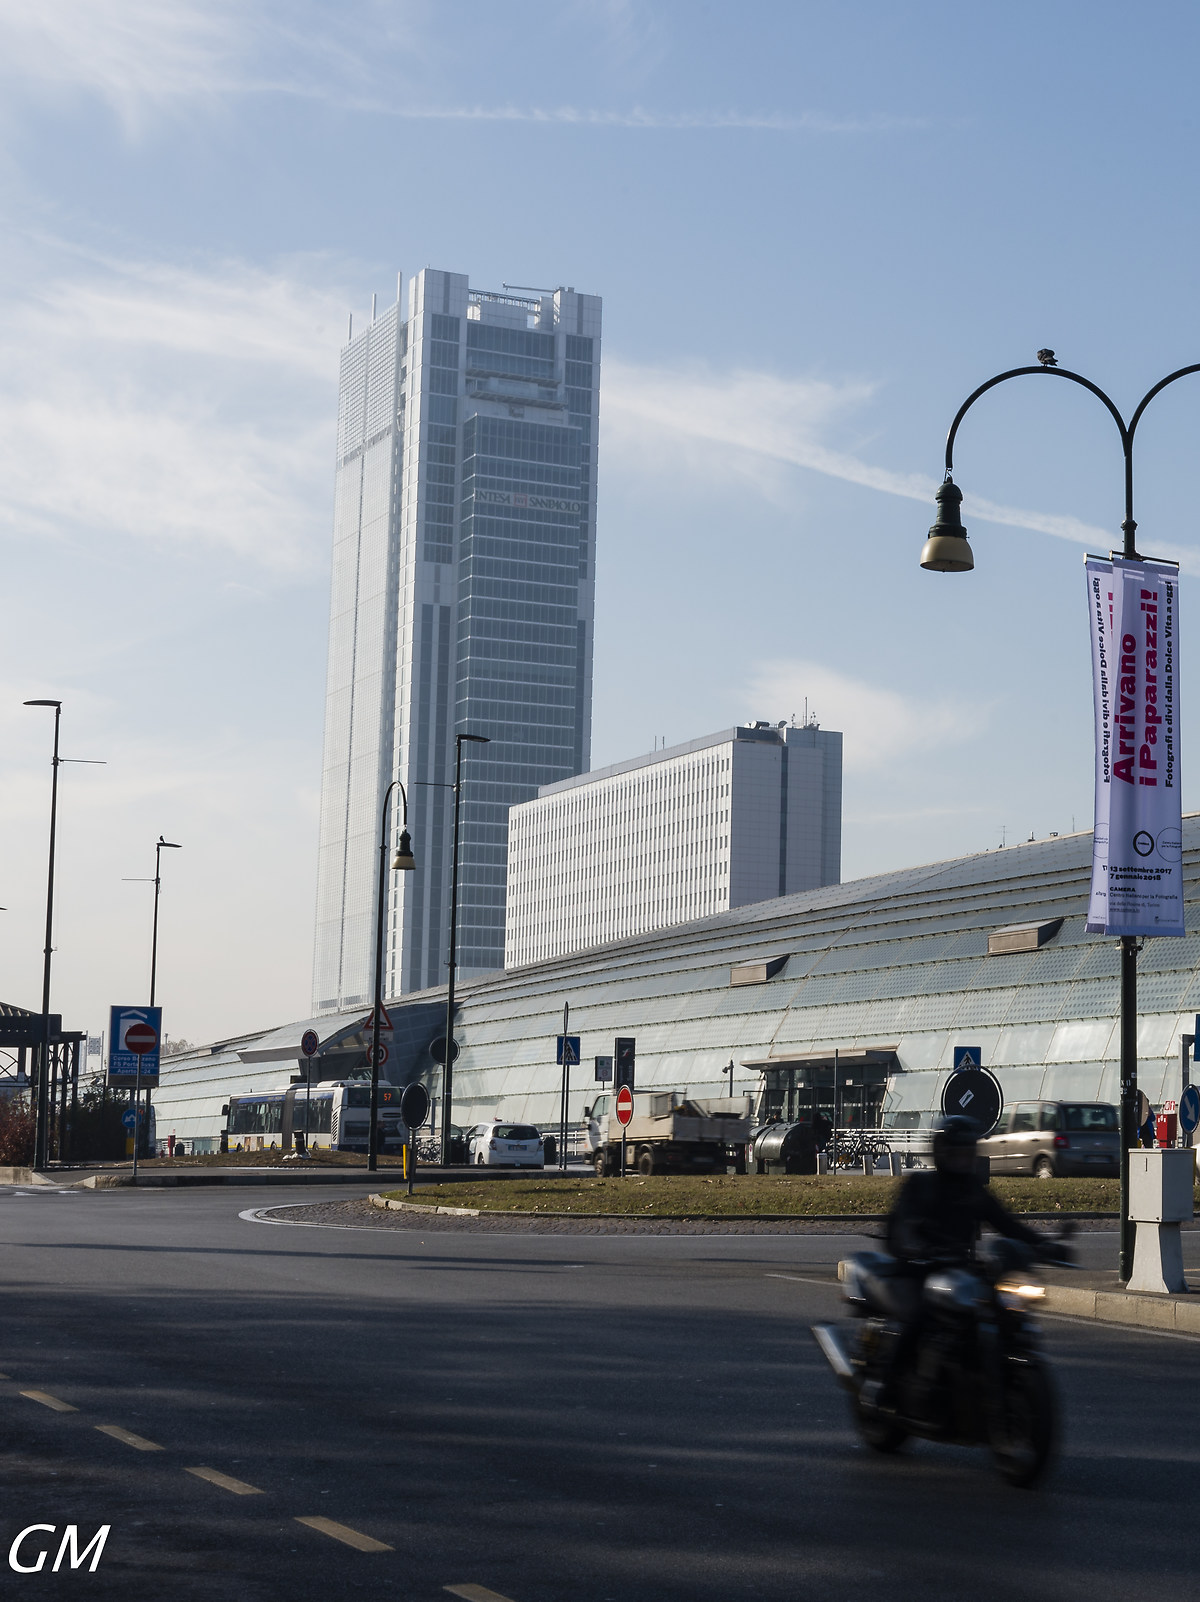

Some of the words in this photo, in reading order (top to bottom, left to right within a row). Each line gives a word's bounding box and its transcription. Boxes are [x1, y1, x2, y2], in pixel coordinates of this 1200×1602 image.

[529, 497, 580, 512] SANPAOLO
[1165, 581, 1174, 605] oggi
[1165, 640, 1173, 673] Dolce
[1139, 589, 1162, 770] Paparazzi!
[1165, 675, 1173, 703] dalla
[1113, 634, 1136, 785] Arrivano
[1165, 704, 1173, 725] divi
[1164, 735, 1174, 787] Fotografi
[1139, 776, 1157, 786] i
[1119, 866, 1154, 874] settembre
[384, 1093, 392, 1101] 57
